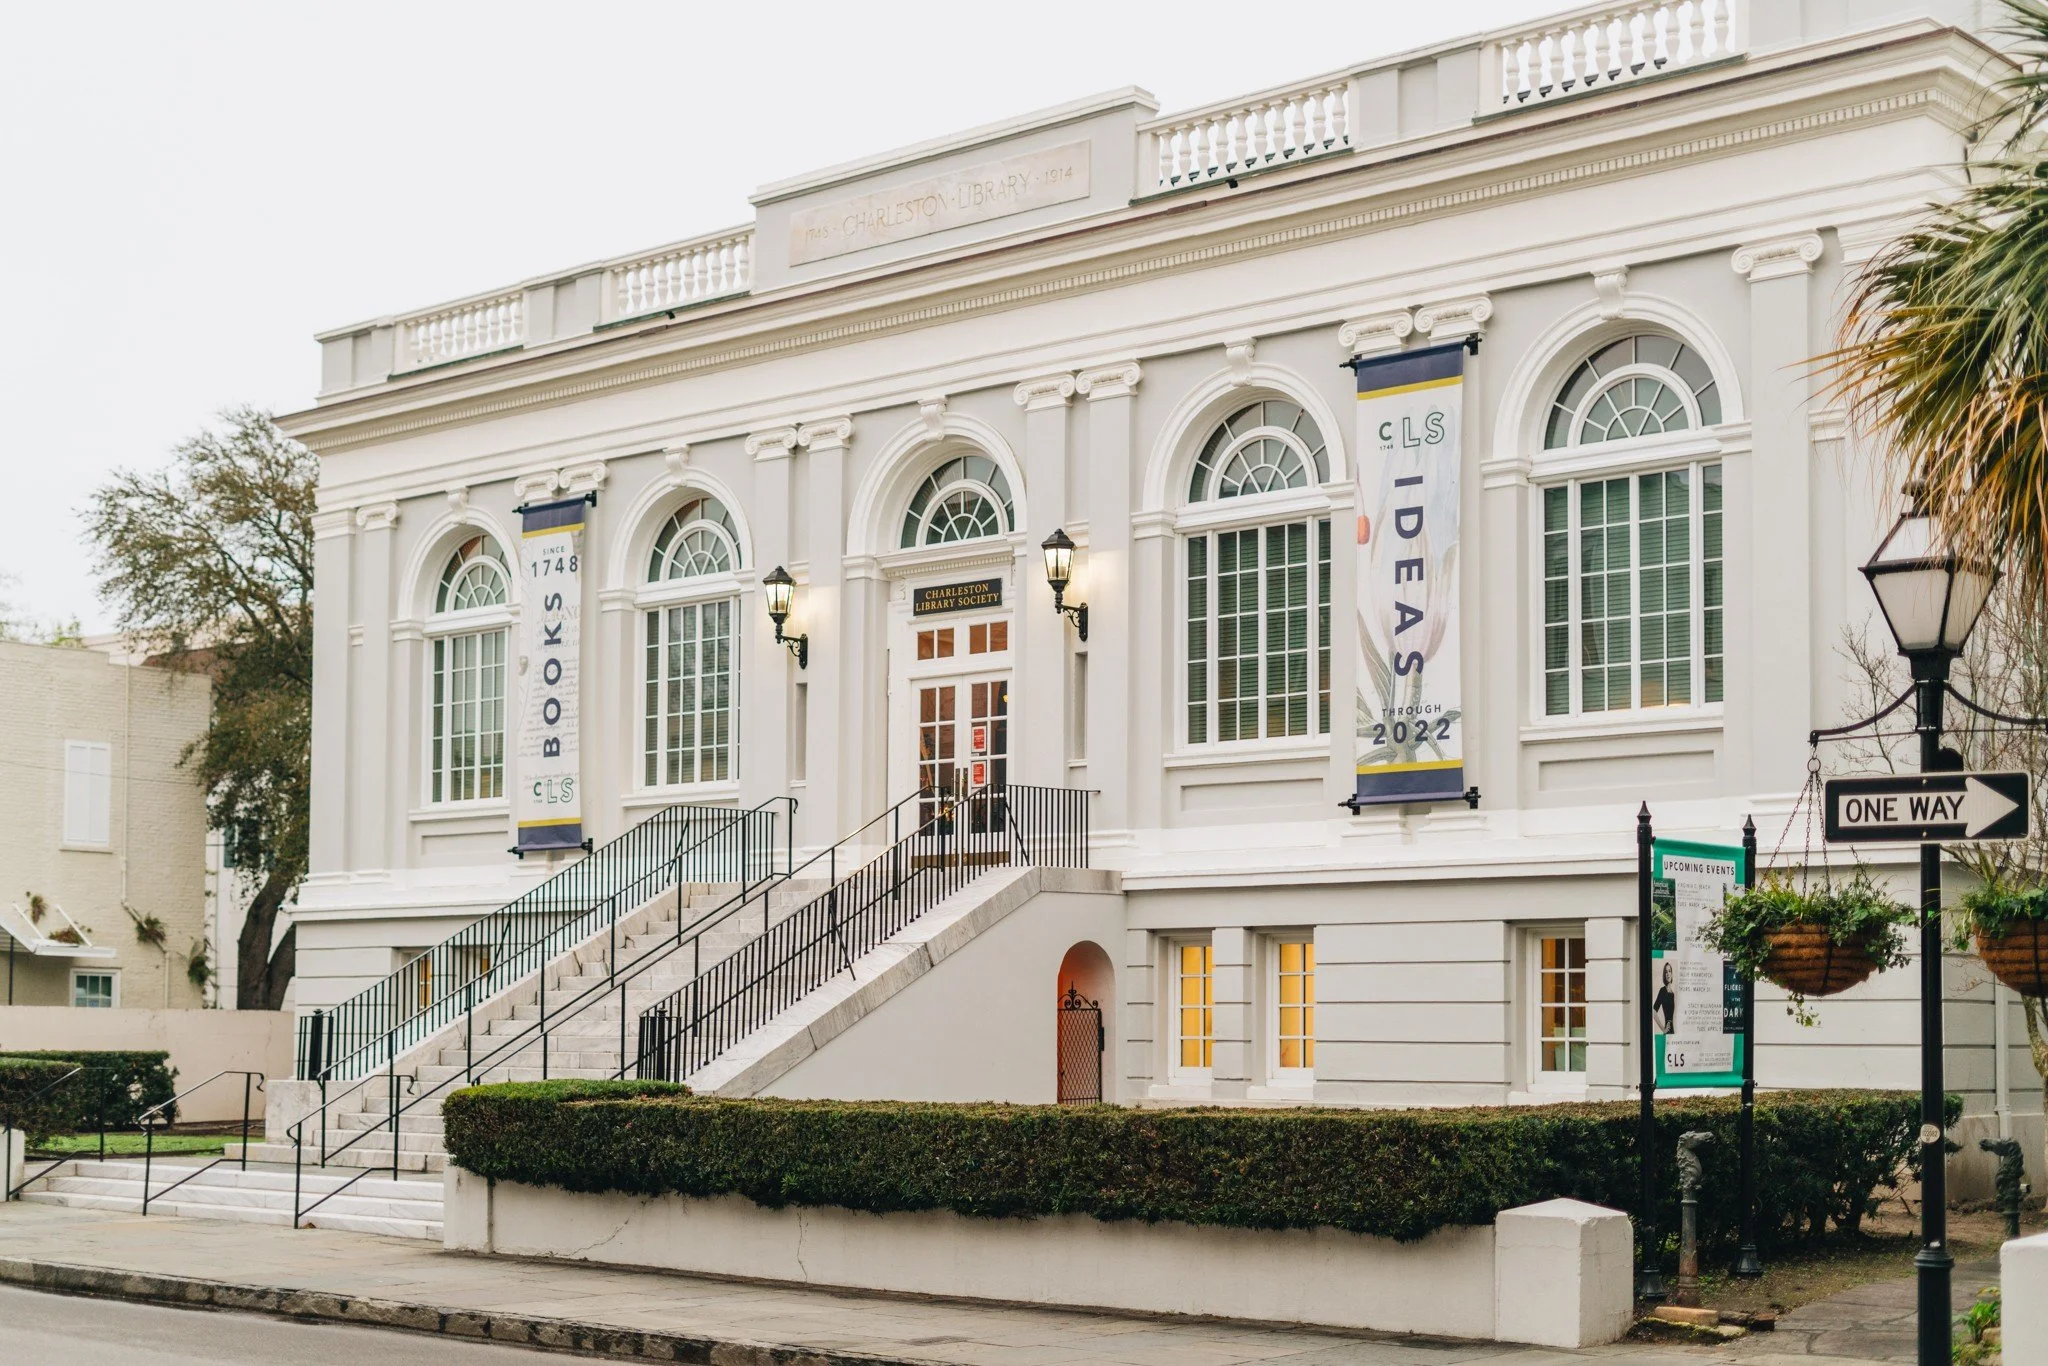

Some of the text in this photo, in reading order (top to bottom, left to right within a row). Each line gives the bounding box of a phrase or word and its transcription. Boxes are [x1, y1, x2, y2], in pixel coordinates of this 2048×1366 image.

[842, 193, 948, 236] CHARLESTON
[958, 172, 1031, 210] LIBRARY
[1044, 166, 1073, 185] 1914
[542, 546, 565, 556] SINCE
[531, 555, 579, 578] 1748
[1394, 475, 1424, 677] IDEAS
[915, 593, 999, 612] LIBRARY SOCIETY
[925, 583, 989, 600] CHARLESTON
[543, 592, 563, 758] BOOKS
[1382, 704, 1441, 717] THROUGH
[1373, 718, 1450, 745] 2022
[1846, 795, 1965, 824] ONE WAY
[1664, 861, 1735, 876] UPCOMING EVENTS
